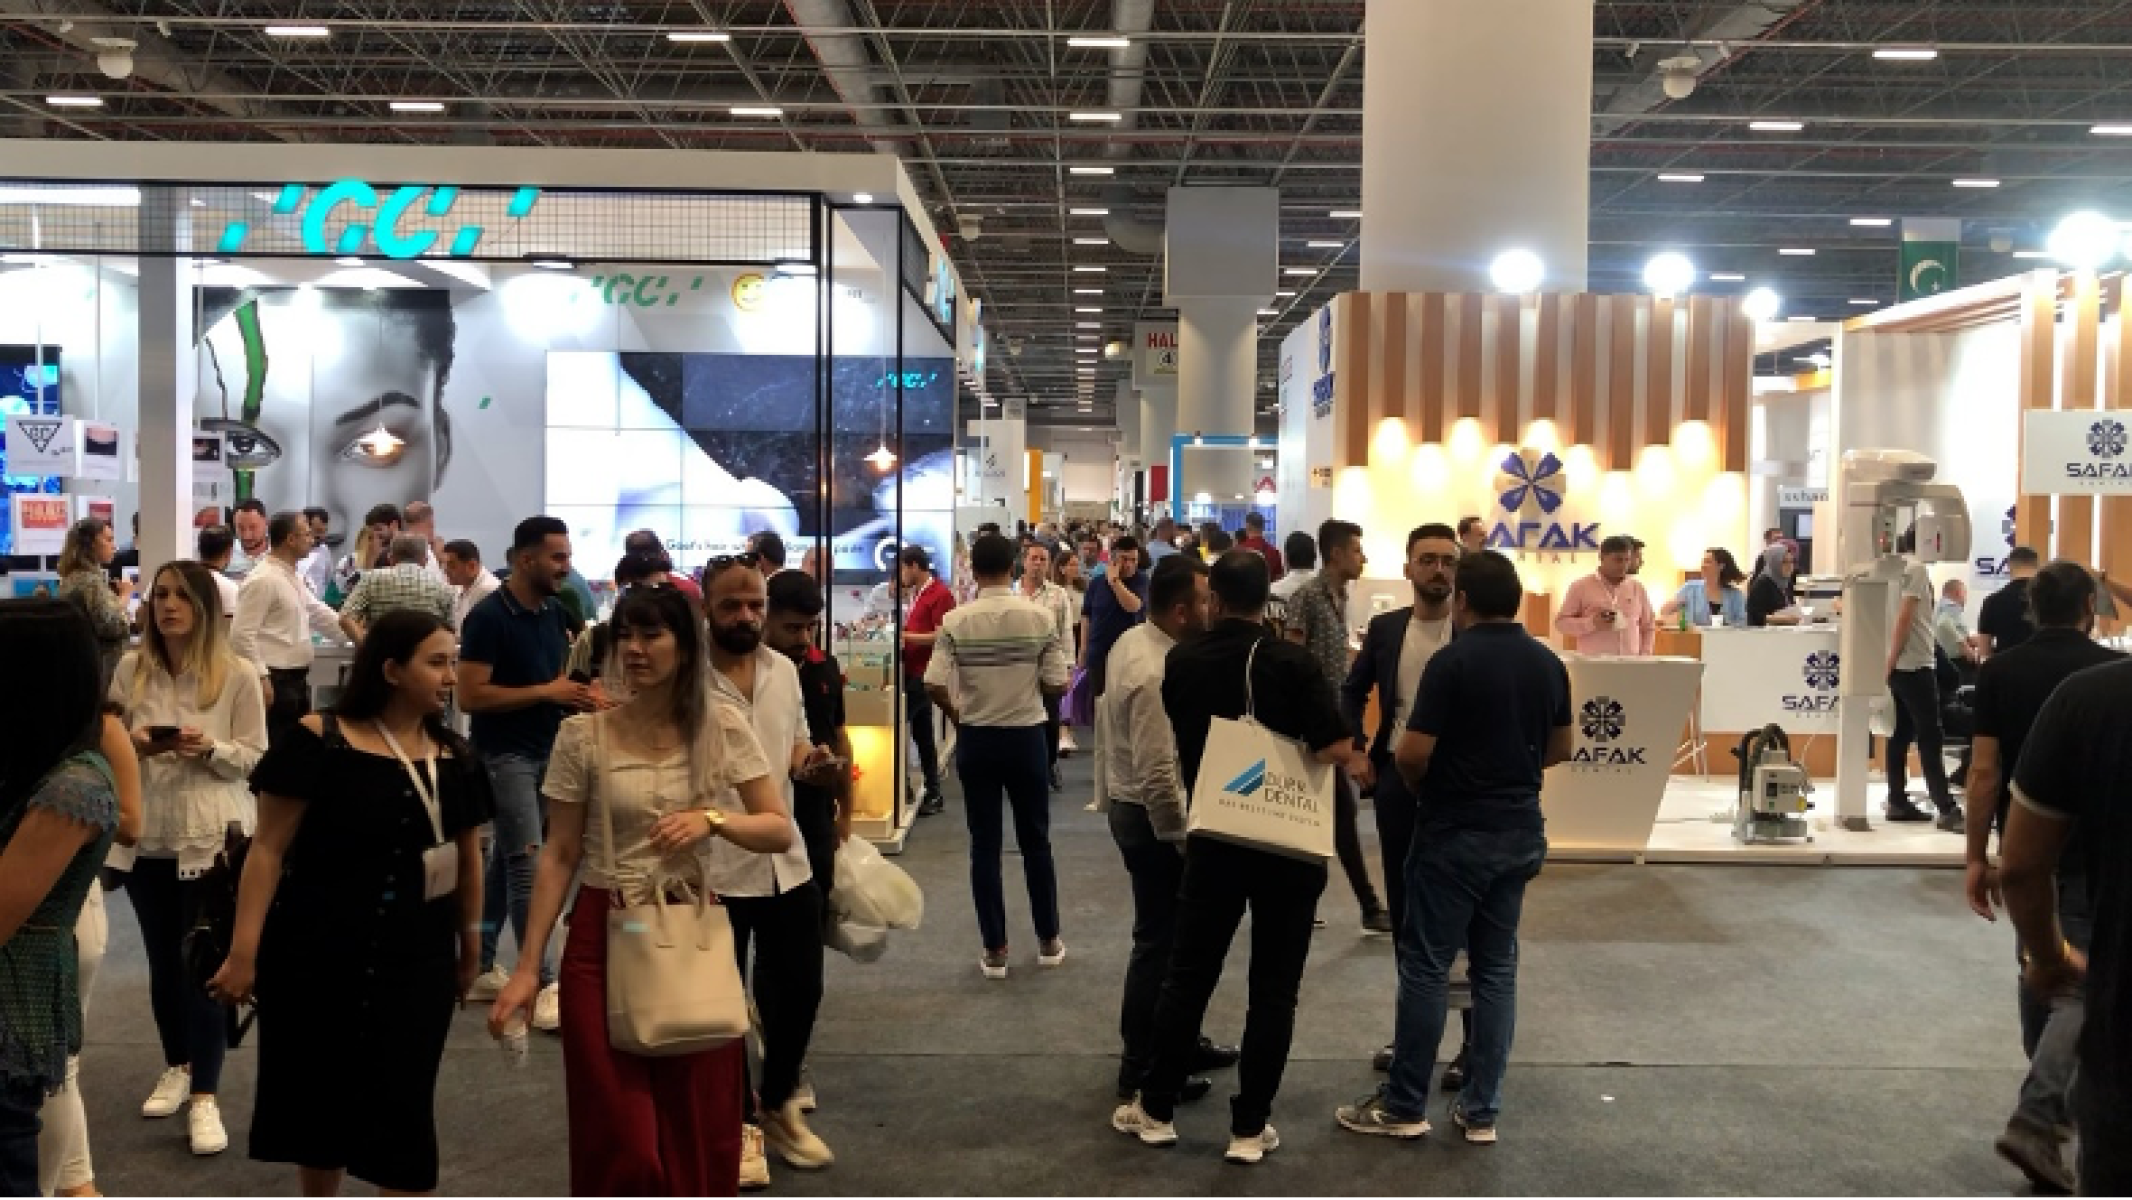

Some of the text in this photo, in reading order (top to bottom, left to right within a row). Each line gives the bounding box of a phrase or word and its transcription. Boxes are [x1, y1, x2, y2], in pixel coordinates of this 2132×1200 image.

[1147, 332, 1178, 348] HAL
[2066, 462, 2132, 478] SAFA
[1485, 522, 1600, 547] AFAK
[1573, 747, 1646, 764] AFAK
